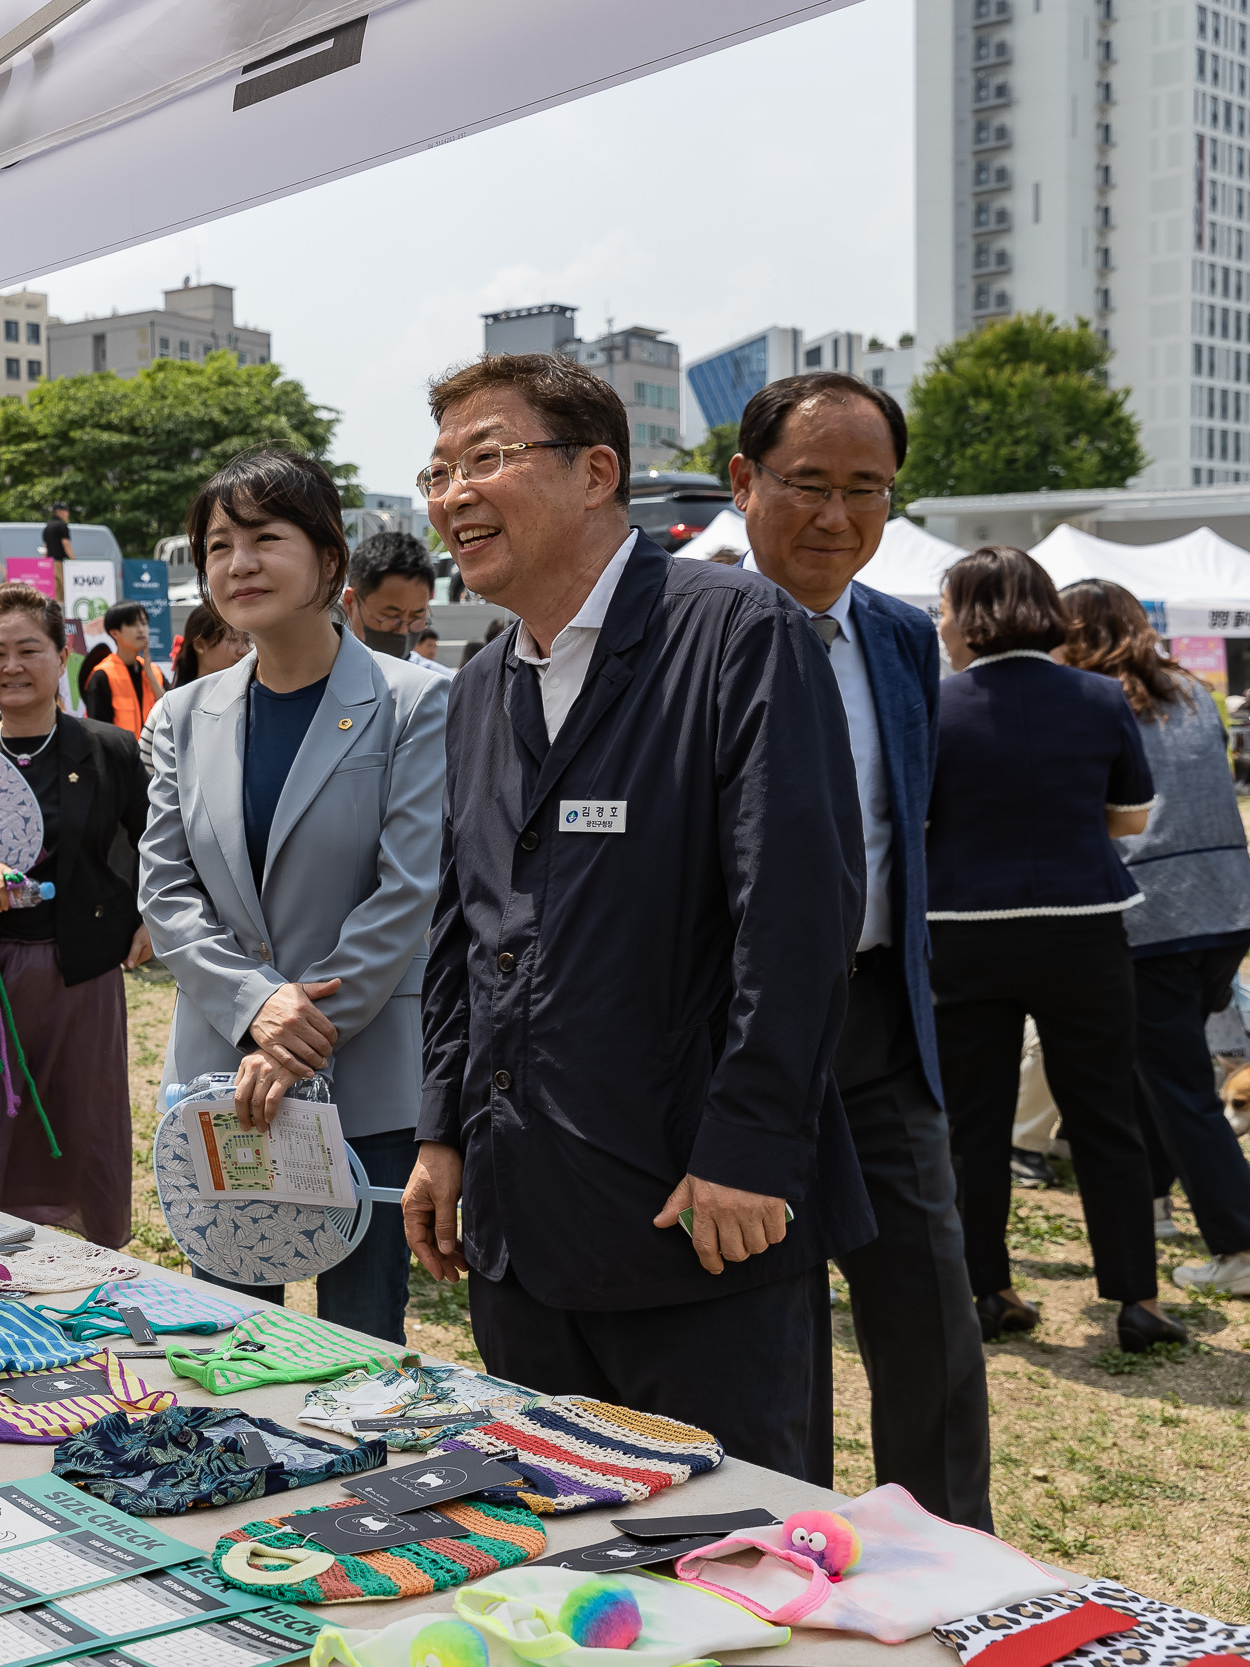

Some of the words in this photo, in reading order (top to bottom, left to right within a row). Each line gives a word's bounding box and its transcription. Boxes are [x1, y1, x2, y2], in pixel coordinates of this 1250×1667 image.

[16, 1498, 35, 1508] 사이즈
[44, 1491, 92, 1517] SIZE
[88, 1514, 167, 1551] CHECK
[176, 1562, 233, 1594] HECK
[250, 1605, 320, 1636] HECK
